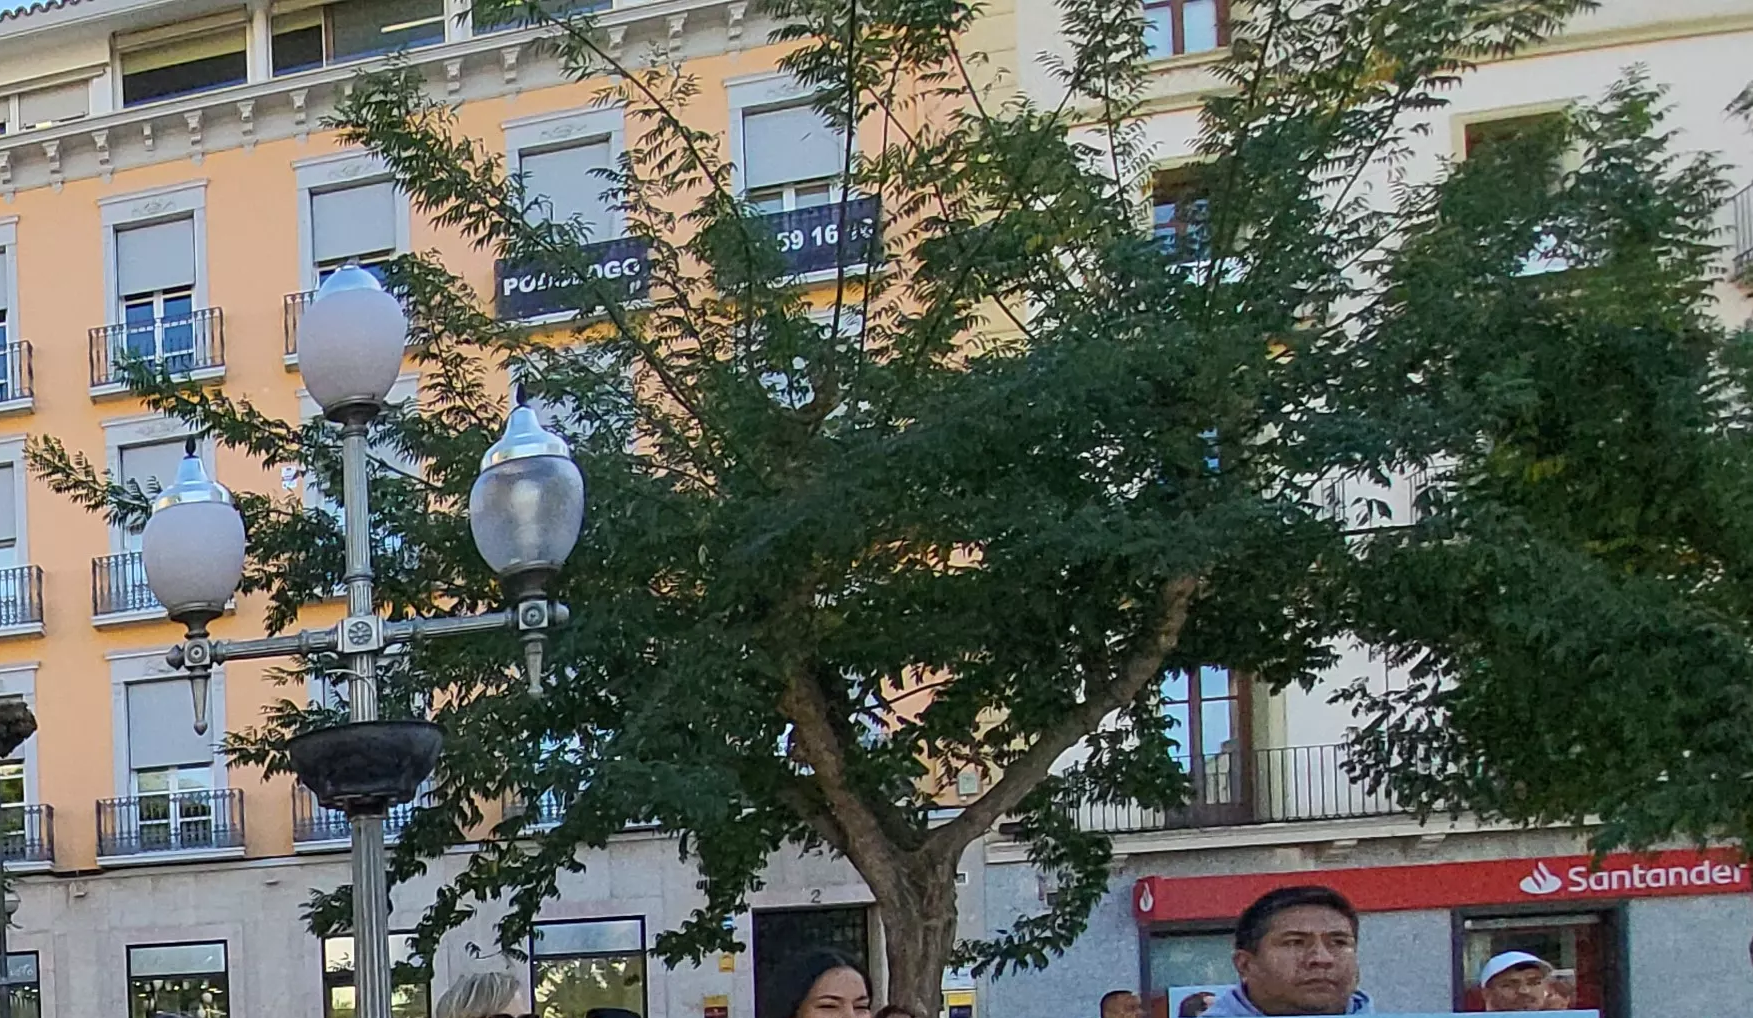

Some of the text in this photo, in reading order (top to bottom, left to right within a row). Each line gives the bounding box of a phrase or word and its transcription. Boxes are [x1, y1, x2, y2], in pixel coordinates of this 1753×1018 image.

[811, 224, 839, 246] 16
[1567, 859, 1747, 892] Santander
[810, 889, 821, 903] 2
